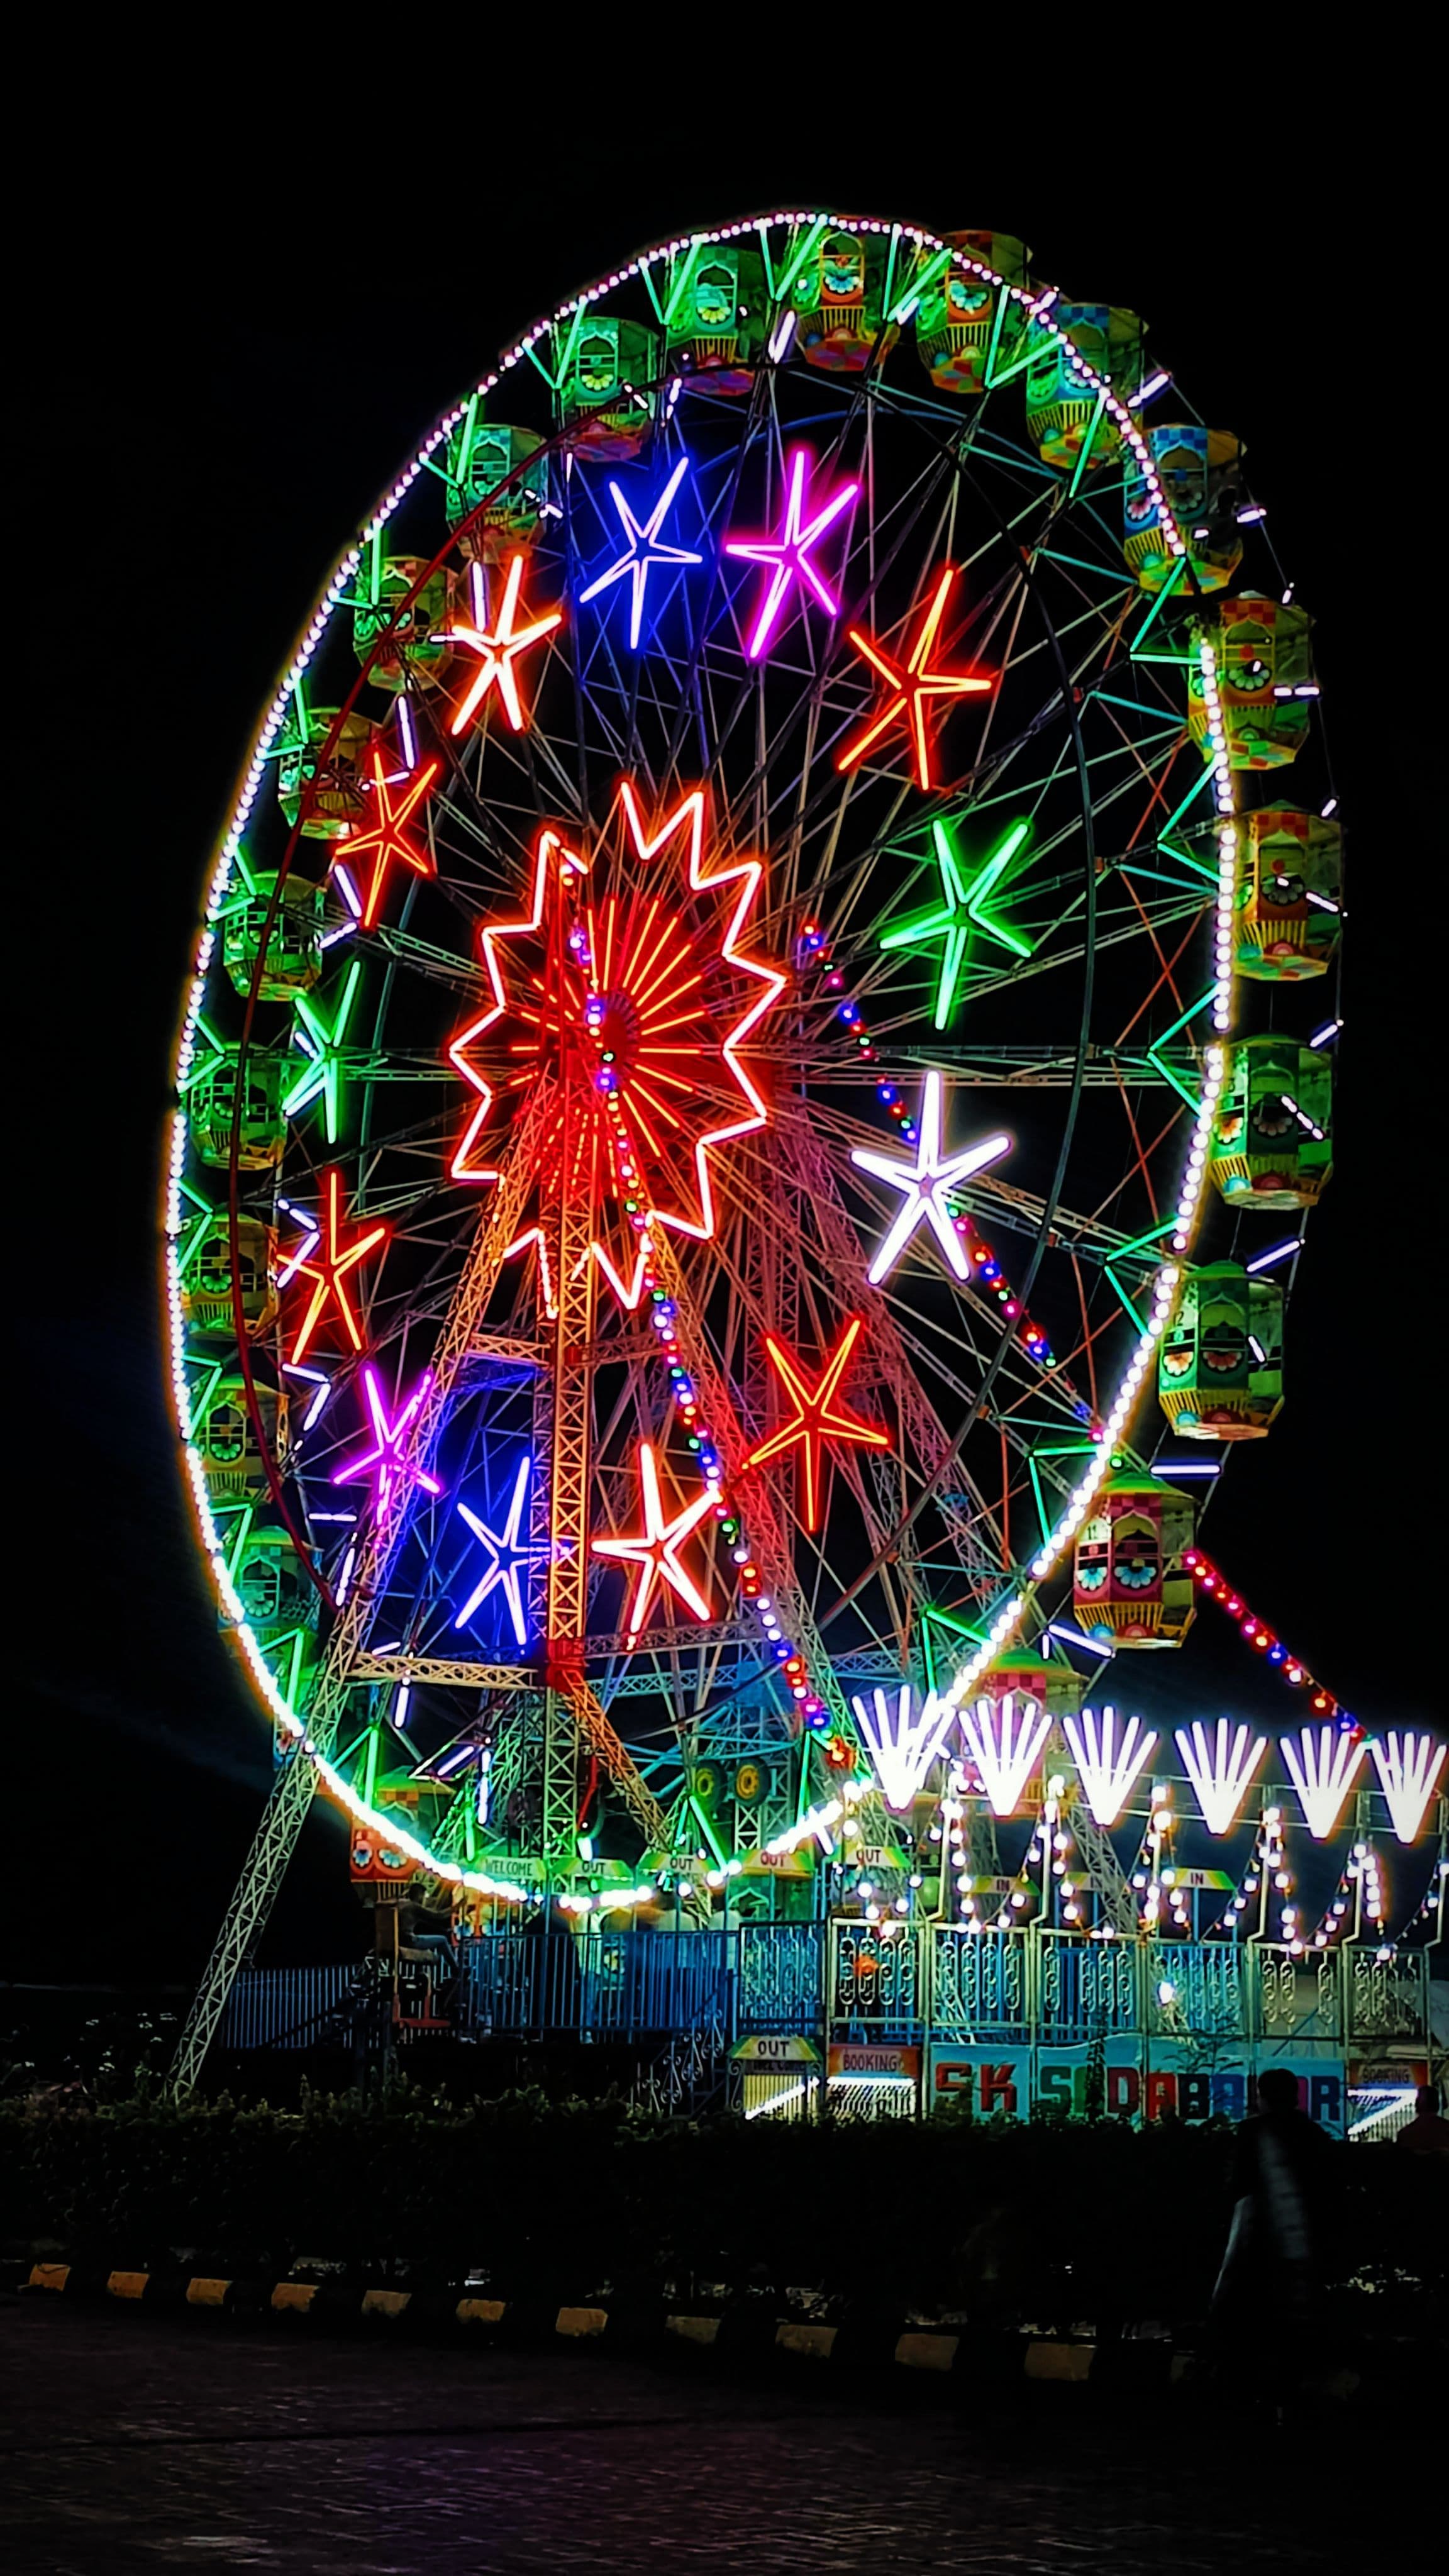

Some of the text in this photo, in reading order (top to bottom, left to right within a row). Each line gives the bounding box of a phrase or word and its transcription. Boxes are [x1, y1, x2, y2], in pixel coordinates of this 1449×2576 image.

[670, 1857, 694, 1870] OUT
[760, 1851, 786, 1867] OUT
[856, 1849, 881, 1863] OUT
[582, 1860, 606, 1874] OUT
[1191, 1872, 1204, 1885] IN
[758, 2040, 790, 2057] OUT
[843, 2053, 897, 2072] BOOKING
[1362, 2067, 1410, 2084] BOOKING
[935, 2062, 1017, 2112] SK
